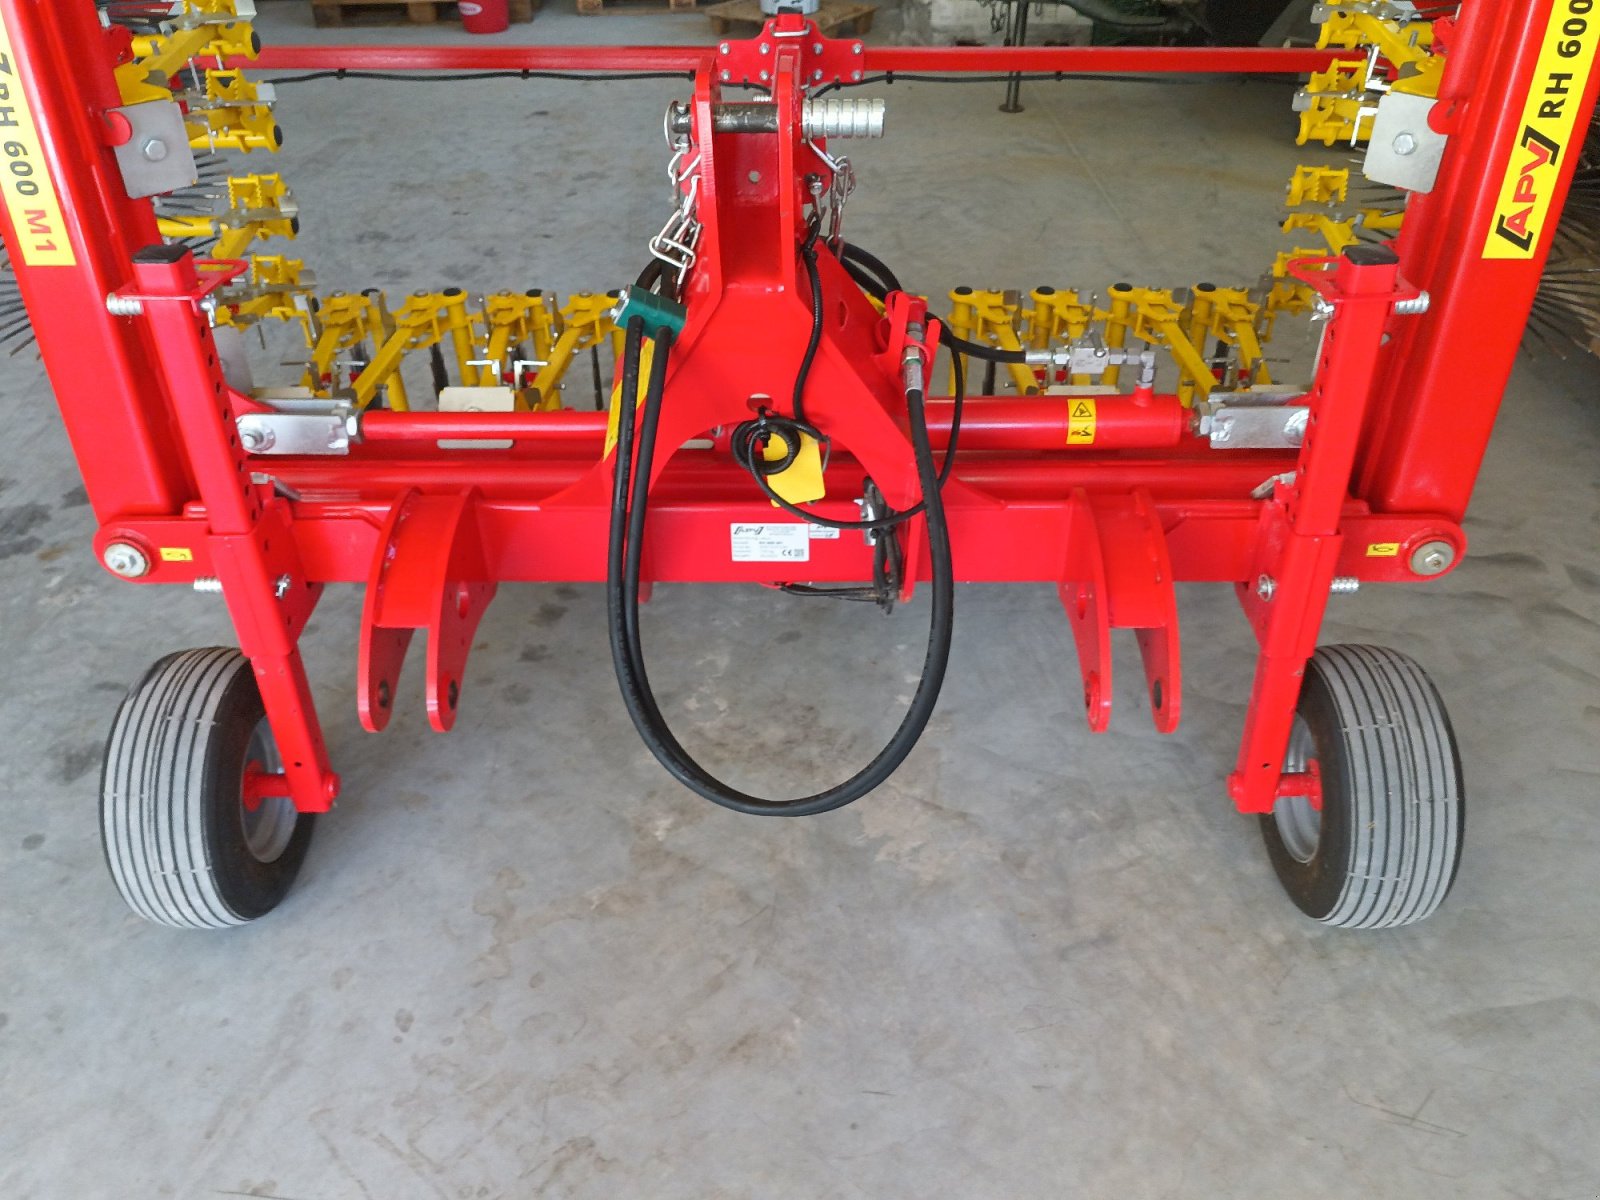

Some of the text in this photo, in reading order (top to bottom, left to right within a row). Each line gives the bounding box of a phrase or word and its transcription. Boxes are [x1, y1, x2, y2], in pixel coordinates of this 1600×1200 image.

[3, 140, 40, 196] 600
[24, 209, 58, 251] M1
[1502, 0, 1594, 241] APV RH 600
